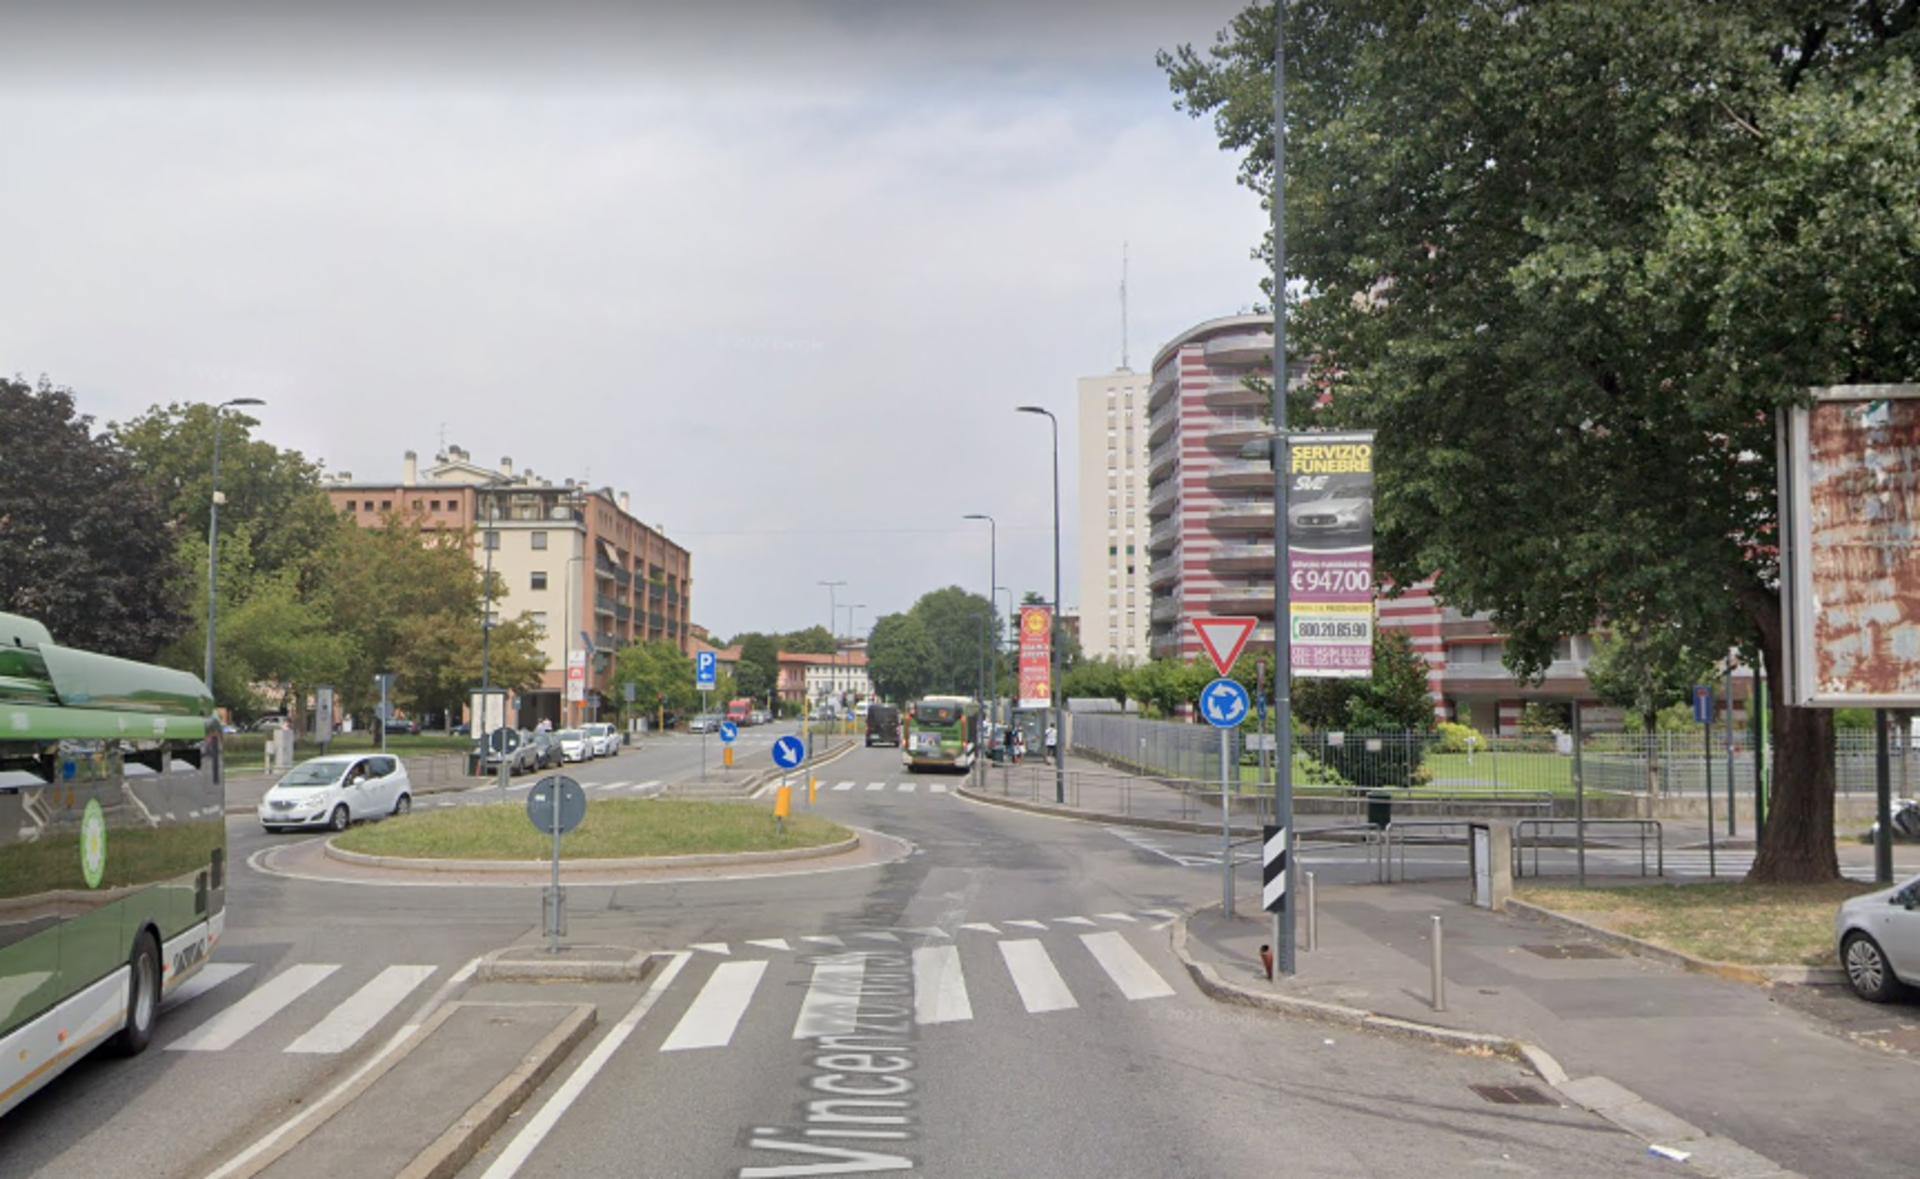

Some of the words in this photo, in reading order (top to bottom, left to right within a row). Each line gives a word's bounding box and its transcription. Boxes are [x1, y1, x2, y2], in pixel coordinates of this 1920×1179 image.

[1291, 444, 1372, 460] SERVIZIO
[1291, 459, 1372, 475] FUNEBRE
[700, 653, 713, 671] P
